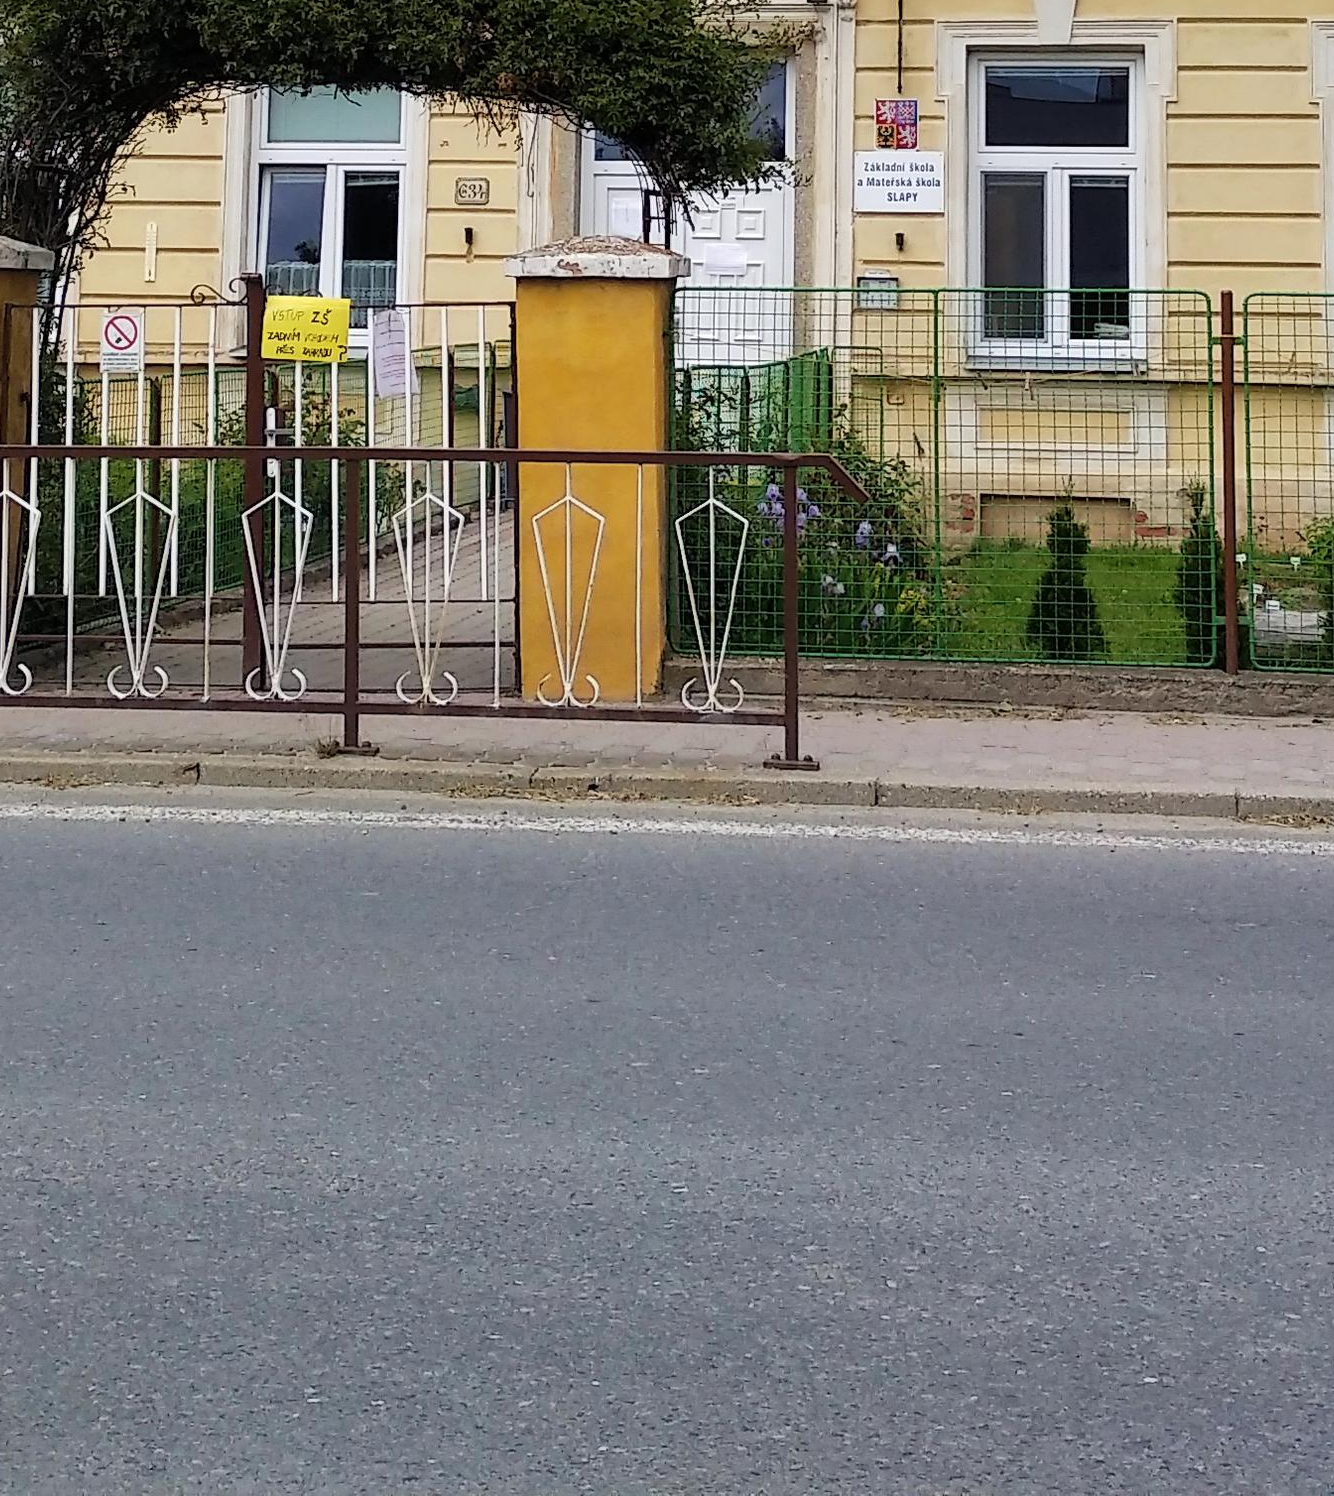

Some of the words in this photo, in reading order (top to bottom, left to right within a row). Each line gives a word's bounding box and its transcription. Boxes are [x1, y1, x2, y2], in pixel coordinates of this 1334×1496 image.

[864, 161, 905, 173] Základní
[909, 161, 935, 173] škola
[866, 177, 913, 187] Mateřská
[916, 177, 941, 187] škola
[887, 192, 918, 202] SLAPY
[311, 308, 332, 326] ZŠ
